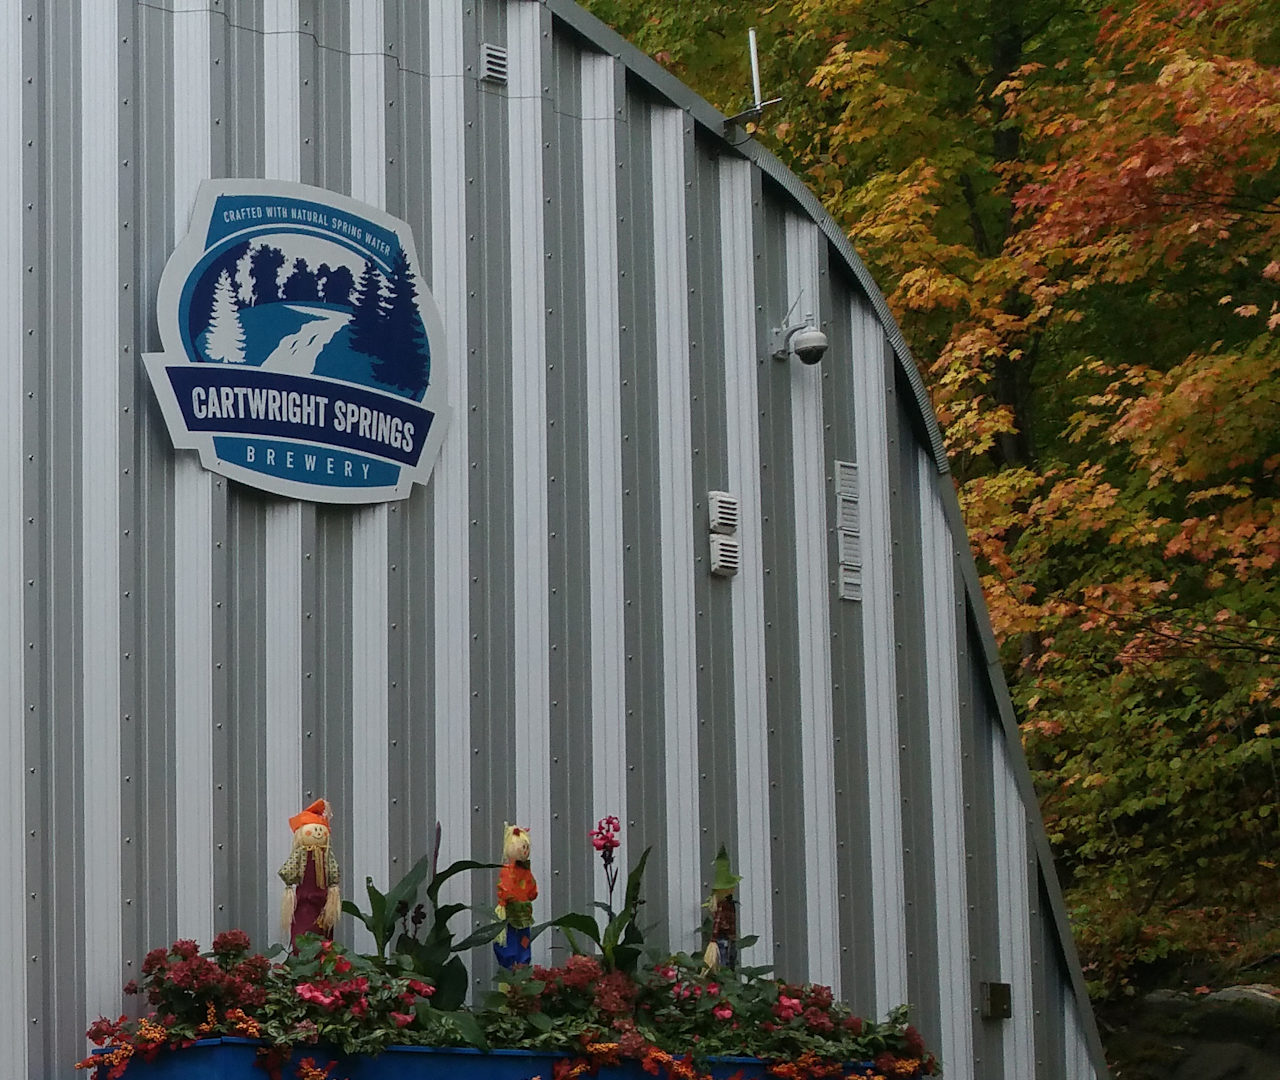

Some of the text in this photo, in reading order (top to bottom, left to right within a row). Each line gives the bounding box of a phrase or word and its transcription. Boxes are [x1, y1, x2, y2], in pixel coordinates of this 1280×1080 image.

[223, 206, 391, 257] CRAFTED WITH NATURAL SPRING WATER
[191, 386, 415, 453] CARTWRIGHT SPRINGS
[246, 445, 371, 480] BREWERY
